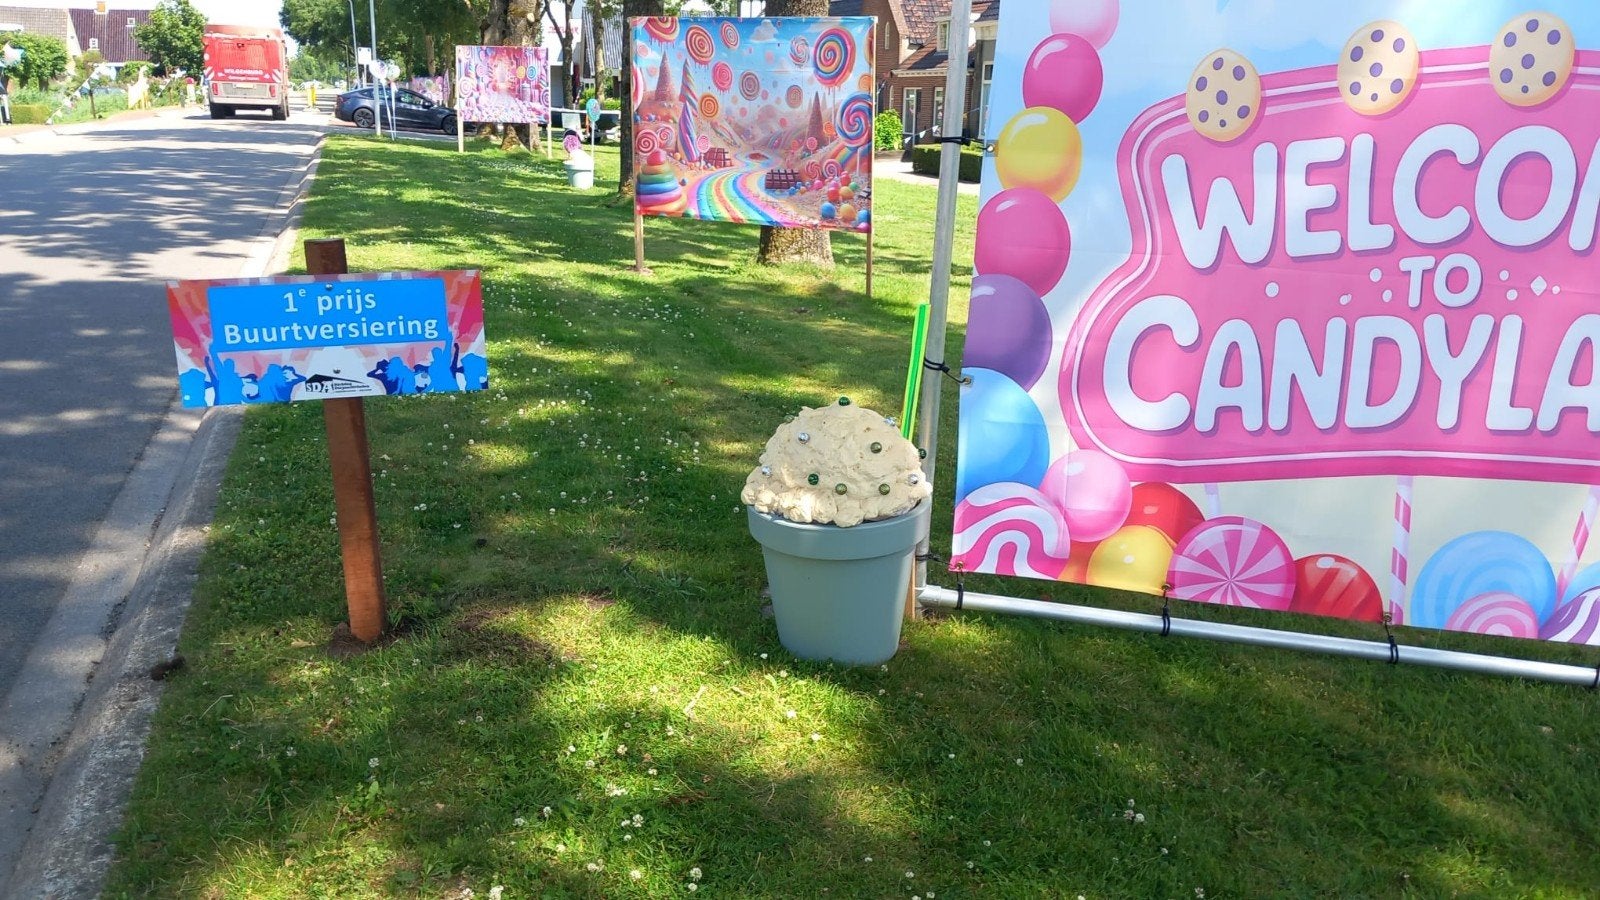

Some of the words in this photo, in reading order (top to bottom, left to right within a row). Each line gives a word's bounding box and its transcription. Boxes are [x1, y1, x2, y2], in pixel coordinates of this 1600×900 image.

[1160, 123, 1600, 268] WELCO
[317, 288, 377, 315] prijs
[1399, 253, 1482, 308] TO
[224, 315, 439, 345] Buurtversiering
[1102, 294, 1600, 432] CANDYLA
[306, 381, 331, 393] SDA
